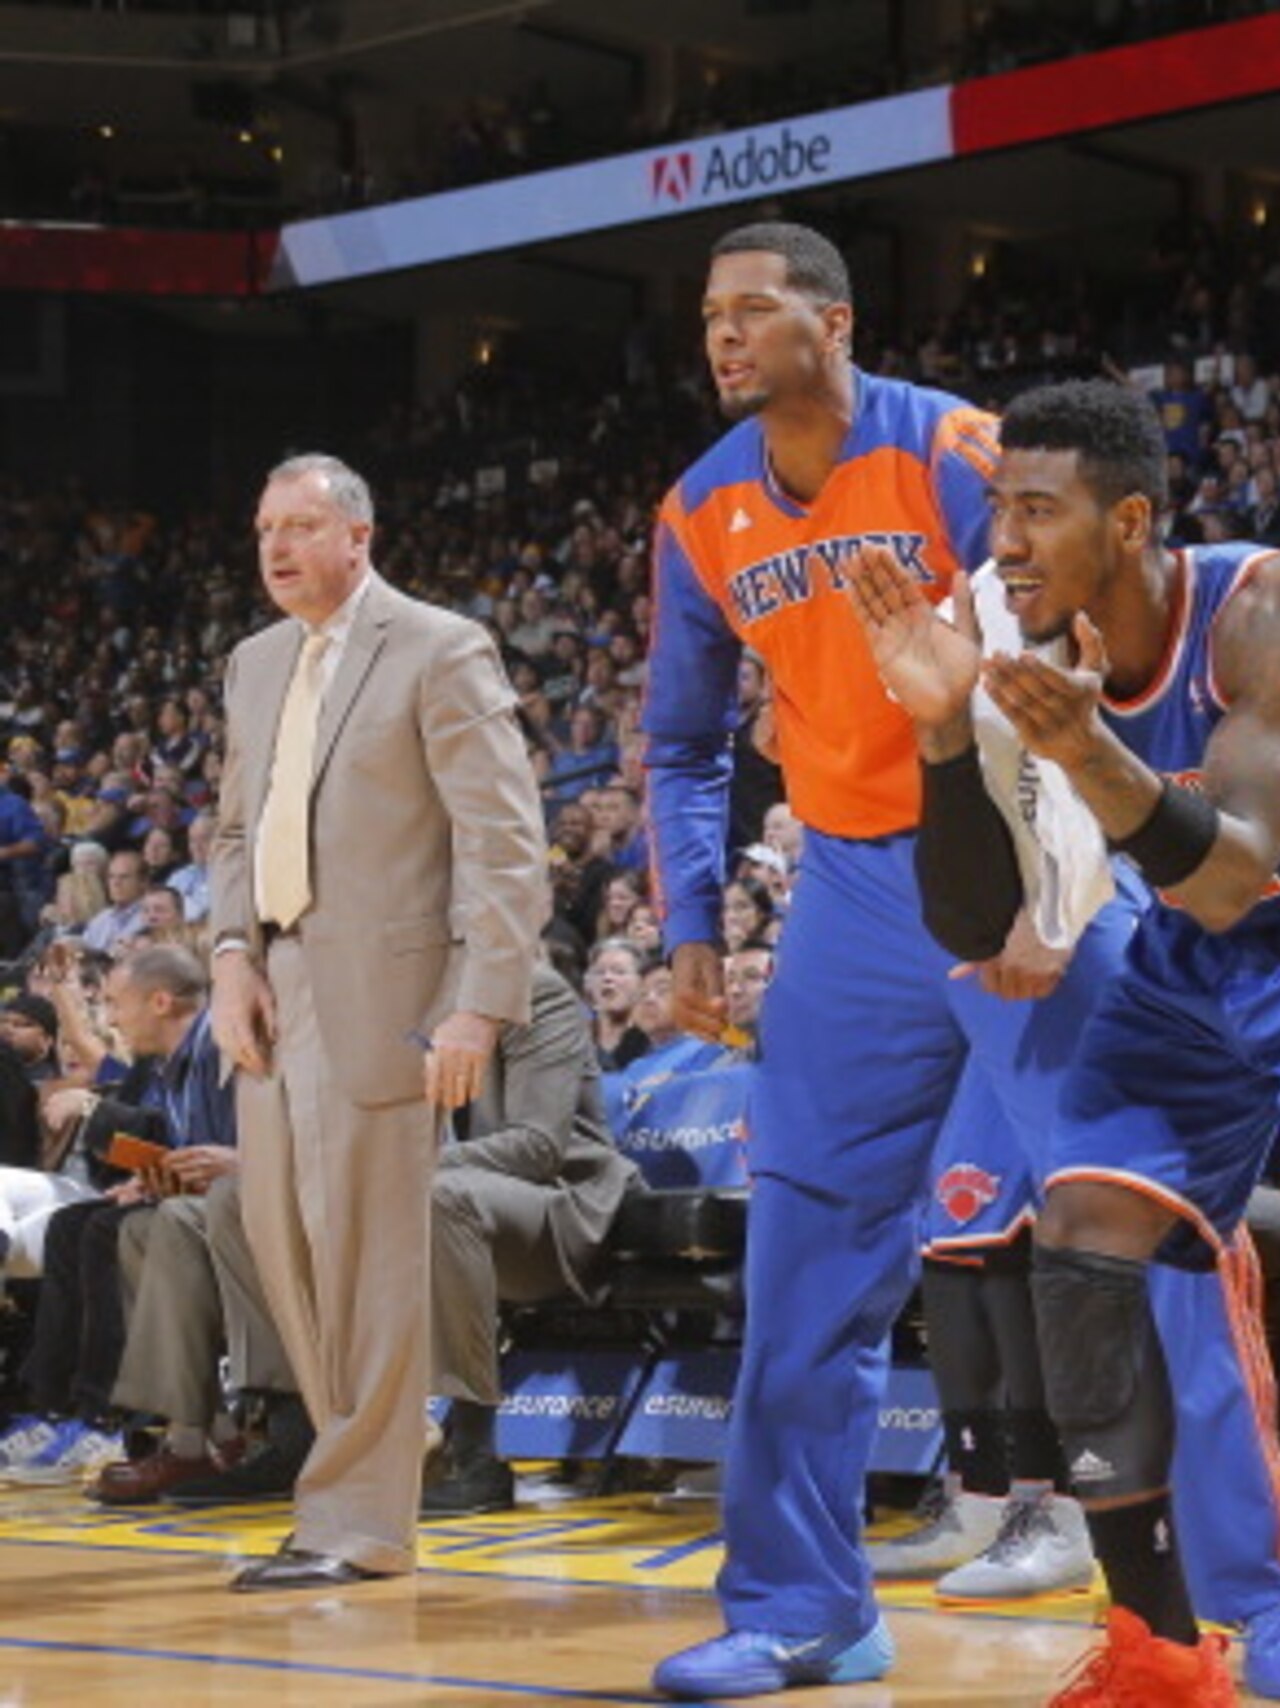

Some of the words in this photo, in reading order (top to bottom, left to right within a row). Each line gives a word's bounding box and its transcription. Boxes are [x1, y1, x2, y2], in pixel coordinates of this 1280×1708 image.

[702, 127, 831, 196] Adobe
[729, 544, 813, 624] NEW
[814, 530, 936, 588] YK
